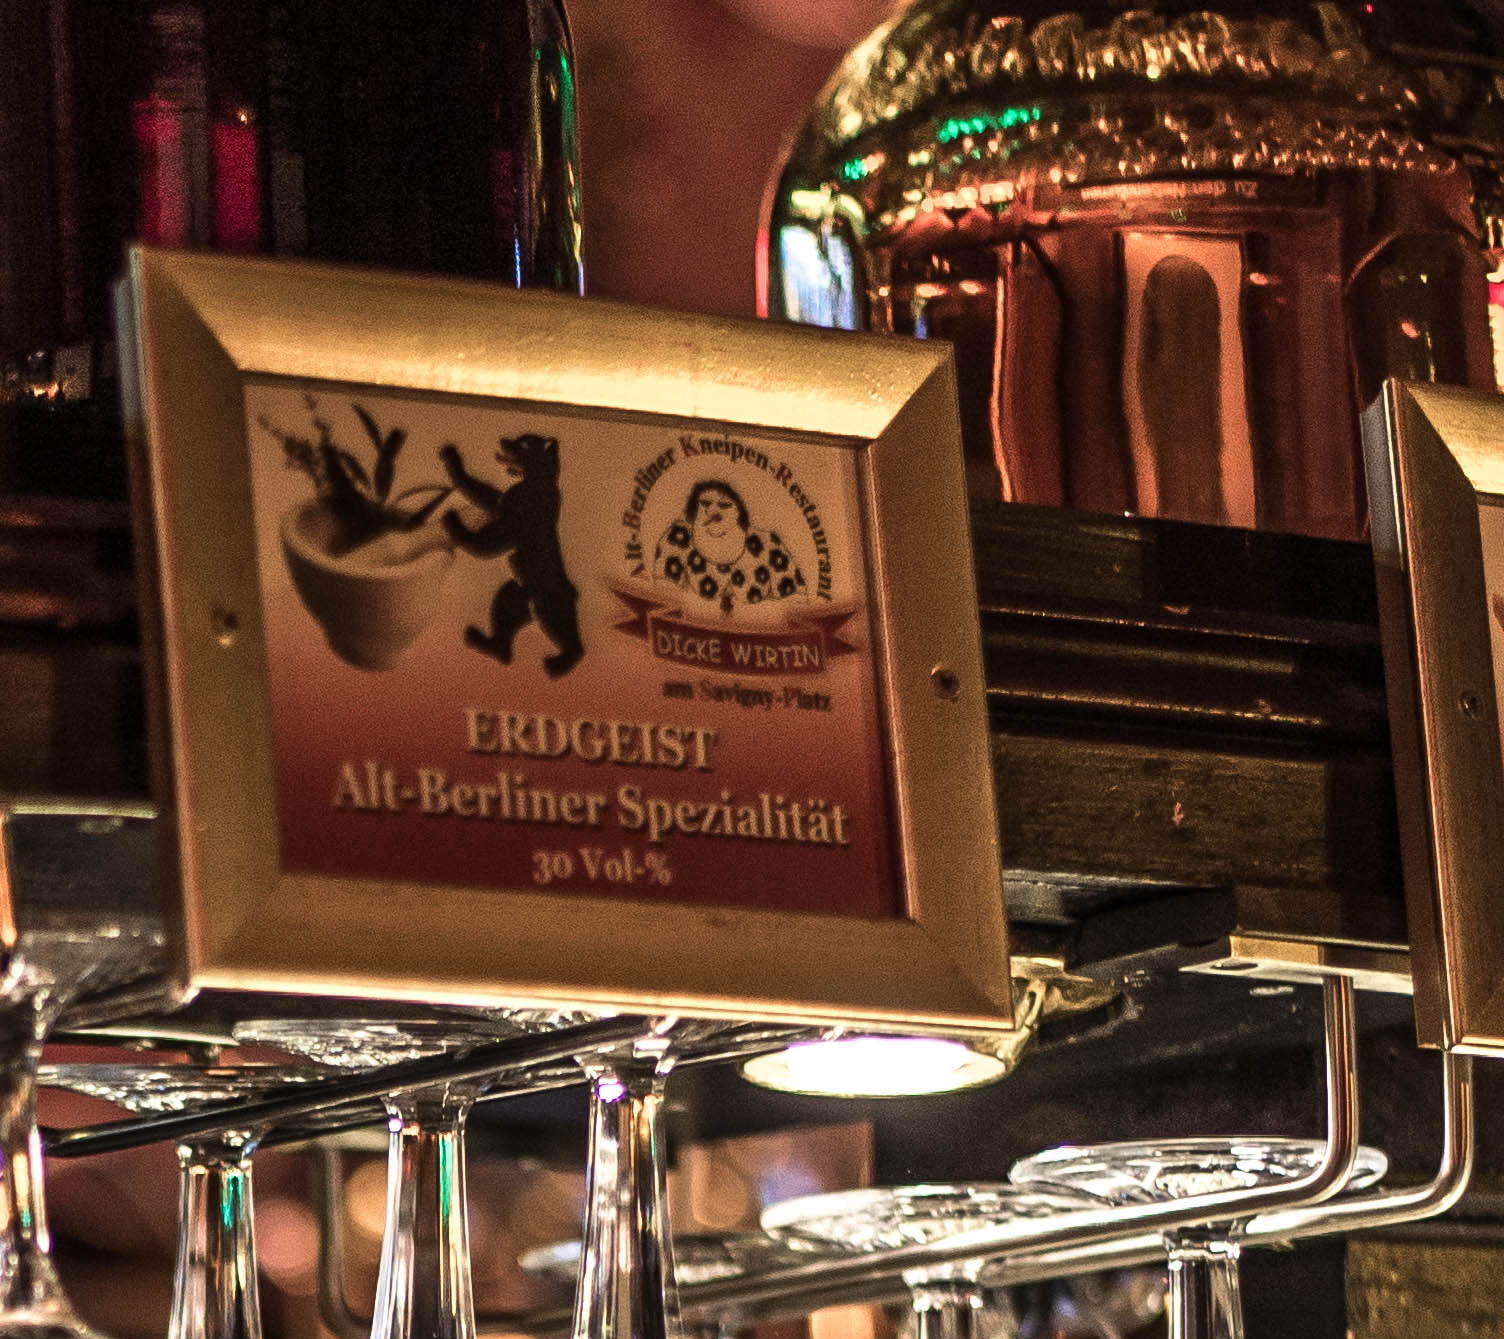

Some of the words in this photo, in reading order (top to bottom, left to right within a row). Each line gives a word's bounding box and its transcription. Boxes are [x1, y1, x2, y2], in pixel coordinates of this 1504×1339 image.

[655, 632, 721, 664] DICKE
[730, 643, 820, 670] WIRTIN
[463, 708, 720, 770] ERDGEIST
[331, 762, 604, 830] Alt-Berliner
[616, 786, 852, 847] Spezialität
[531, 849, 574, 885] 30
